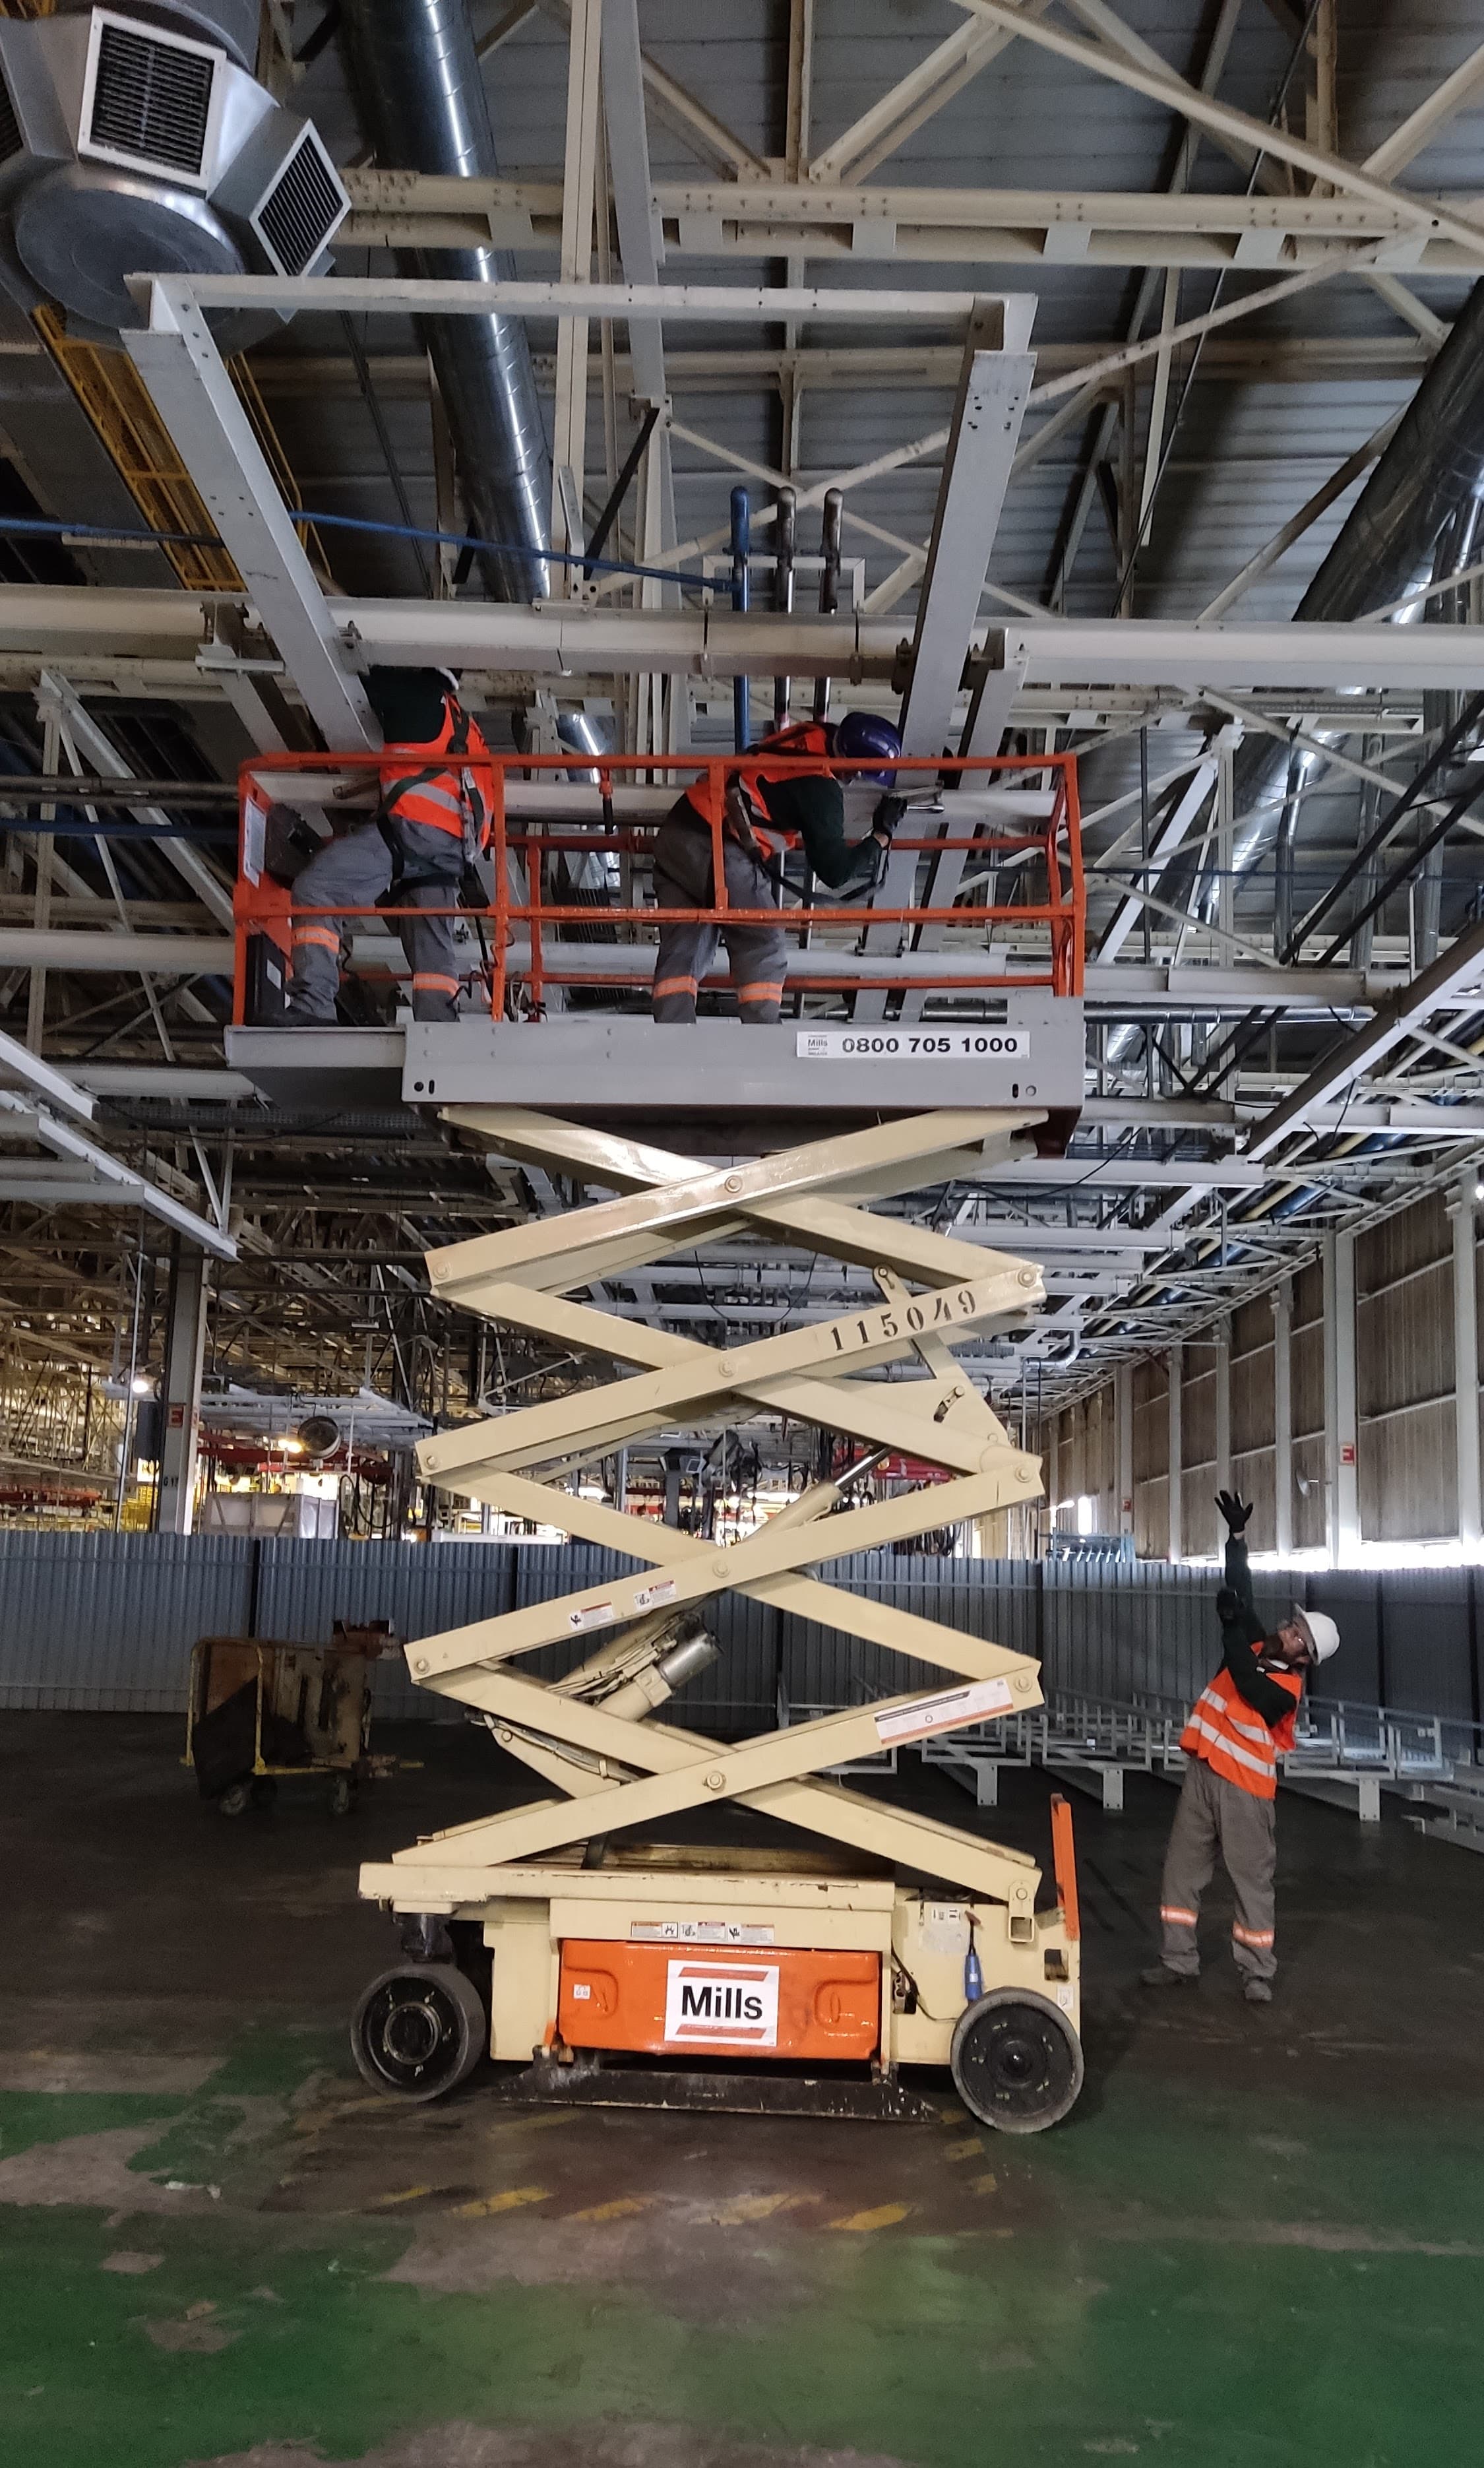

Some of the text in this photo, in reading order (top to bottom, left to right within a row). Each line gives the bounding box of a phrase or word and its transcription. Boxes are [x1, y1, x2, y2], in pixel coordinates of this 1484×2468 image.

[842, 1038, 1018, 1053] 0800 705 1000
[830, 1290, 976, 1351] 115049
[682, 1985, 763, 2020] Mills
